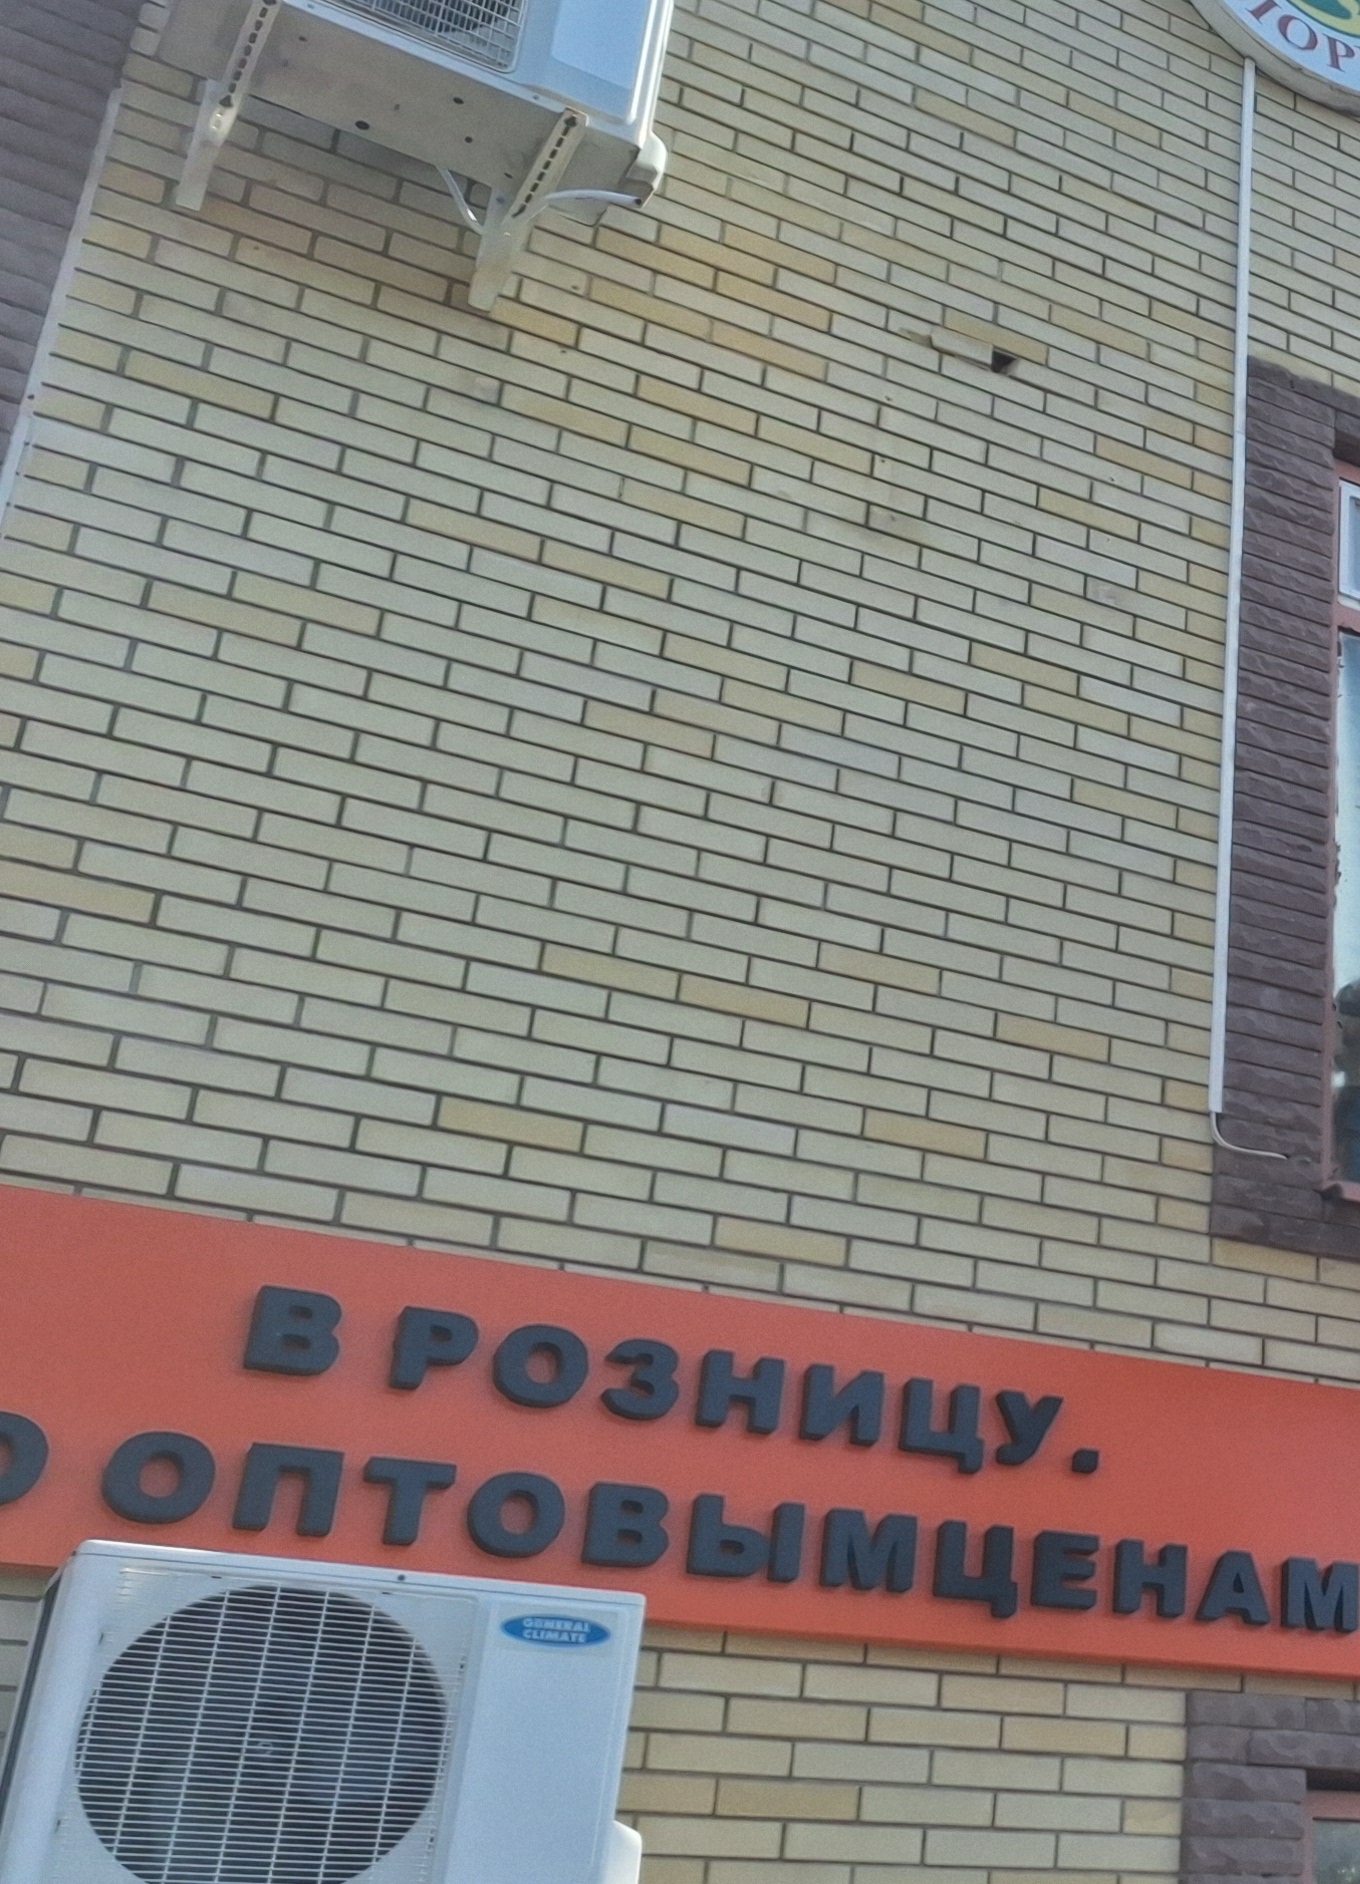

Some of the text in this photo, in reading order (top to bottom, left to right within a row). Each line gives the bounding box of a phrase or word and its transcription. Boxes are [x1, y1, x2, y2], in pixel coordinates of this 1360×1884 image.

[243, 1285, 1099, 1474] В РОЗНИЦУ.
[522, 1617, 591, 1633] GENERAL
[522, 1629, 587, 1643] CLIMATE
